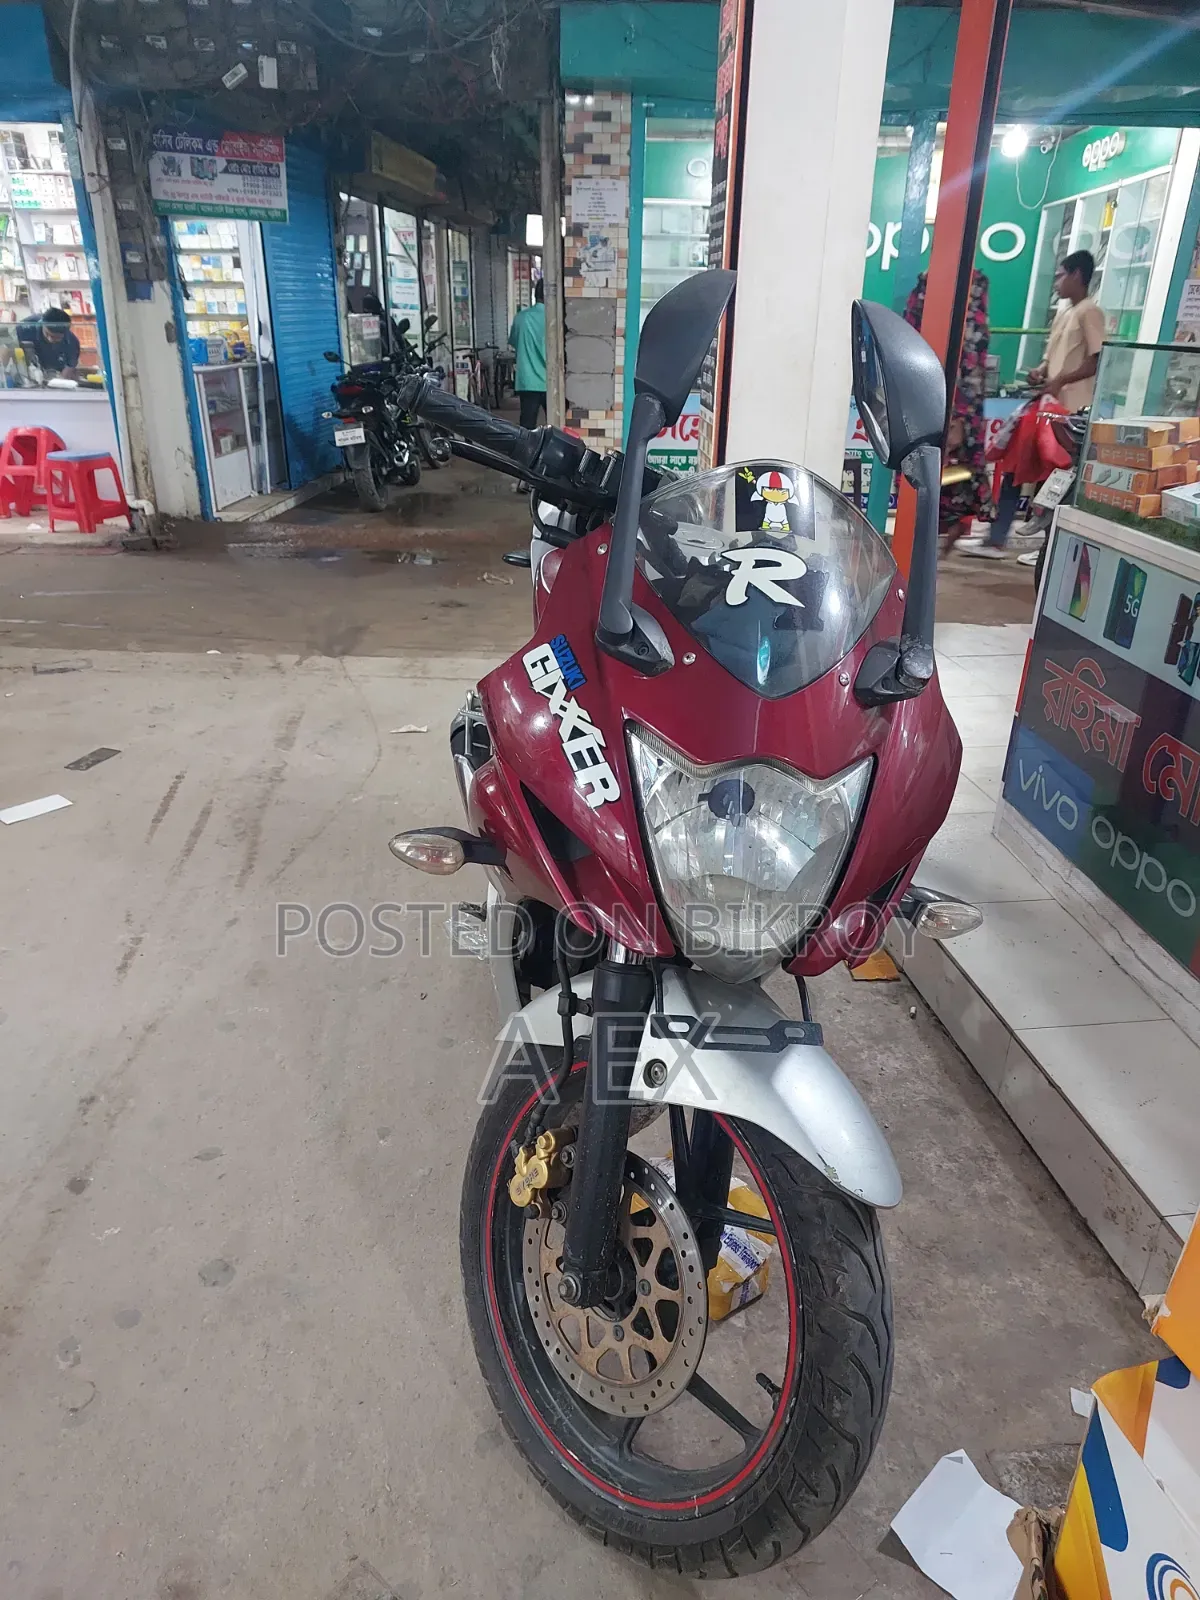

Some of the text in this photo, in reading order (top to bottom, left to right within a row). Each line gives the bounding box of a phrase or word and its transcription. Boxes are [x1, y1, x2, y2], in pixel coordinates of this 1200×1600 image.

[1082, 131, 1124, 172] oppo
[721, 547, 807, 608] R
[1123, 598, 1139, 617] 5G
[550, 634, 588, 691] SUZUKI
[522, 643, 621, 808] GIXXER
[1042, 657, 1142, 774] রহিমা
[1019, 758, 1197, 918] vivo oppo
[723, 1232, 761, 1271] Express Transport
